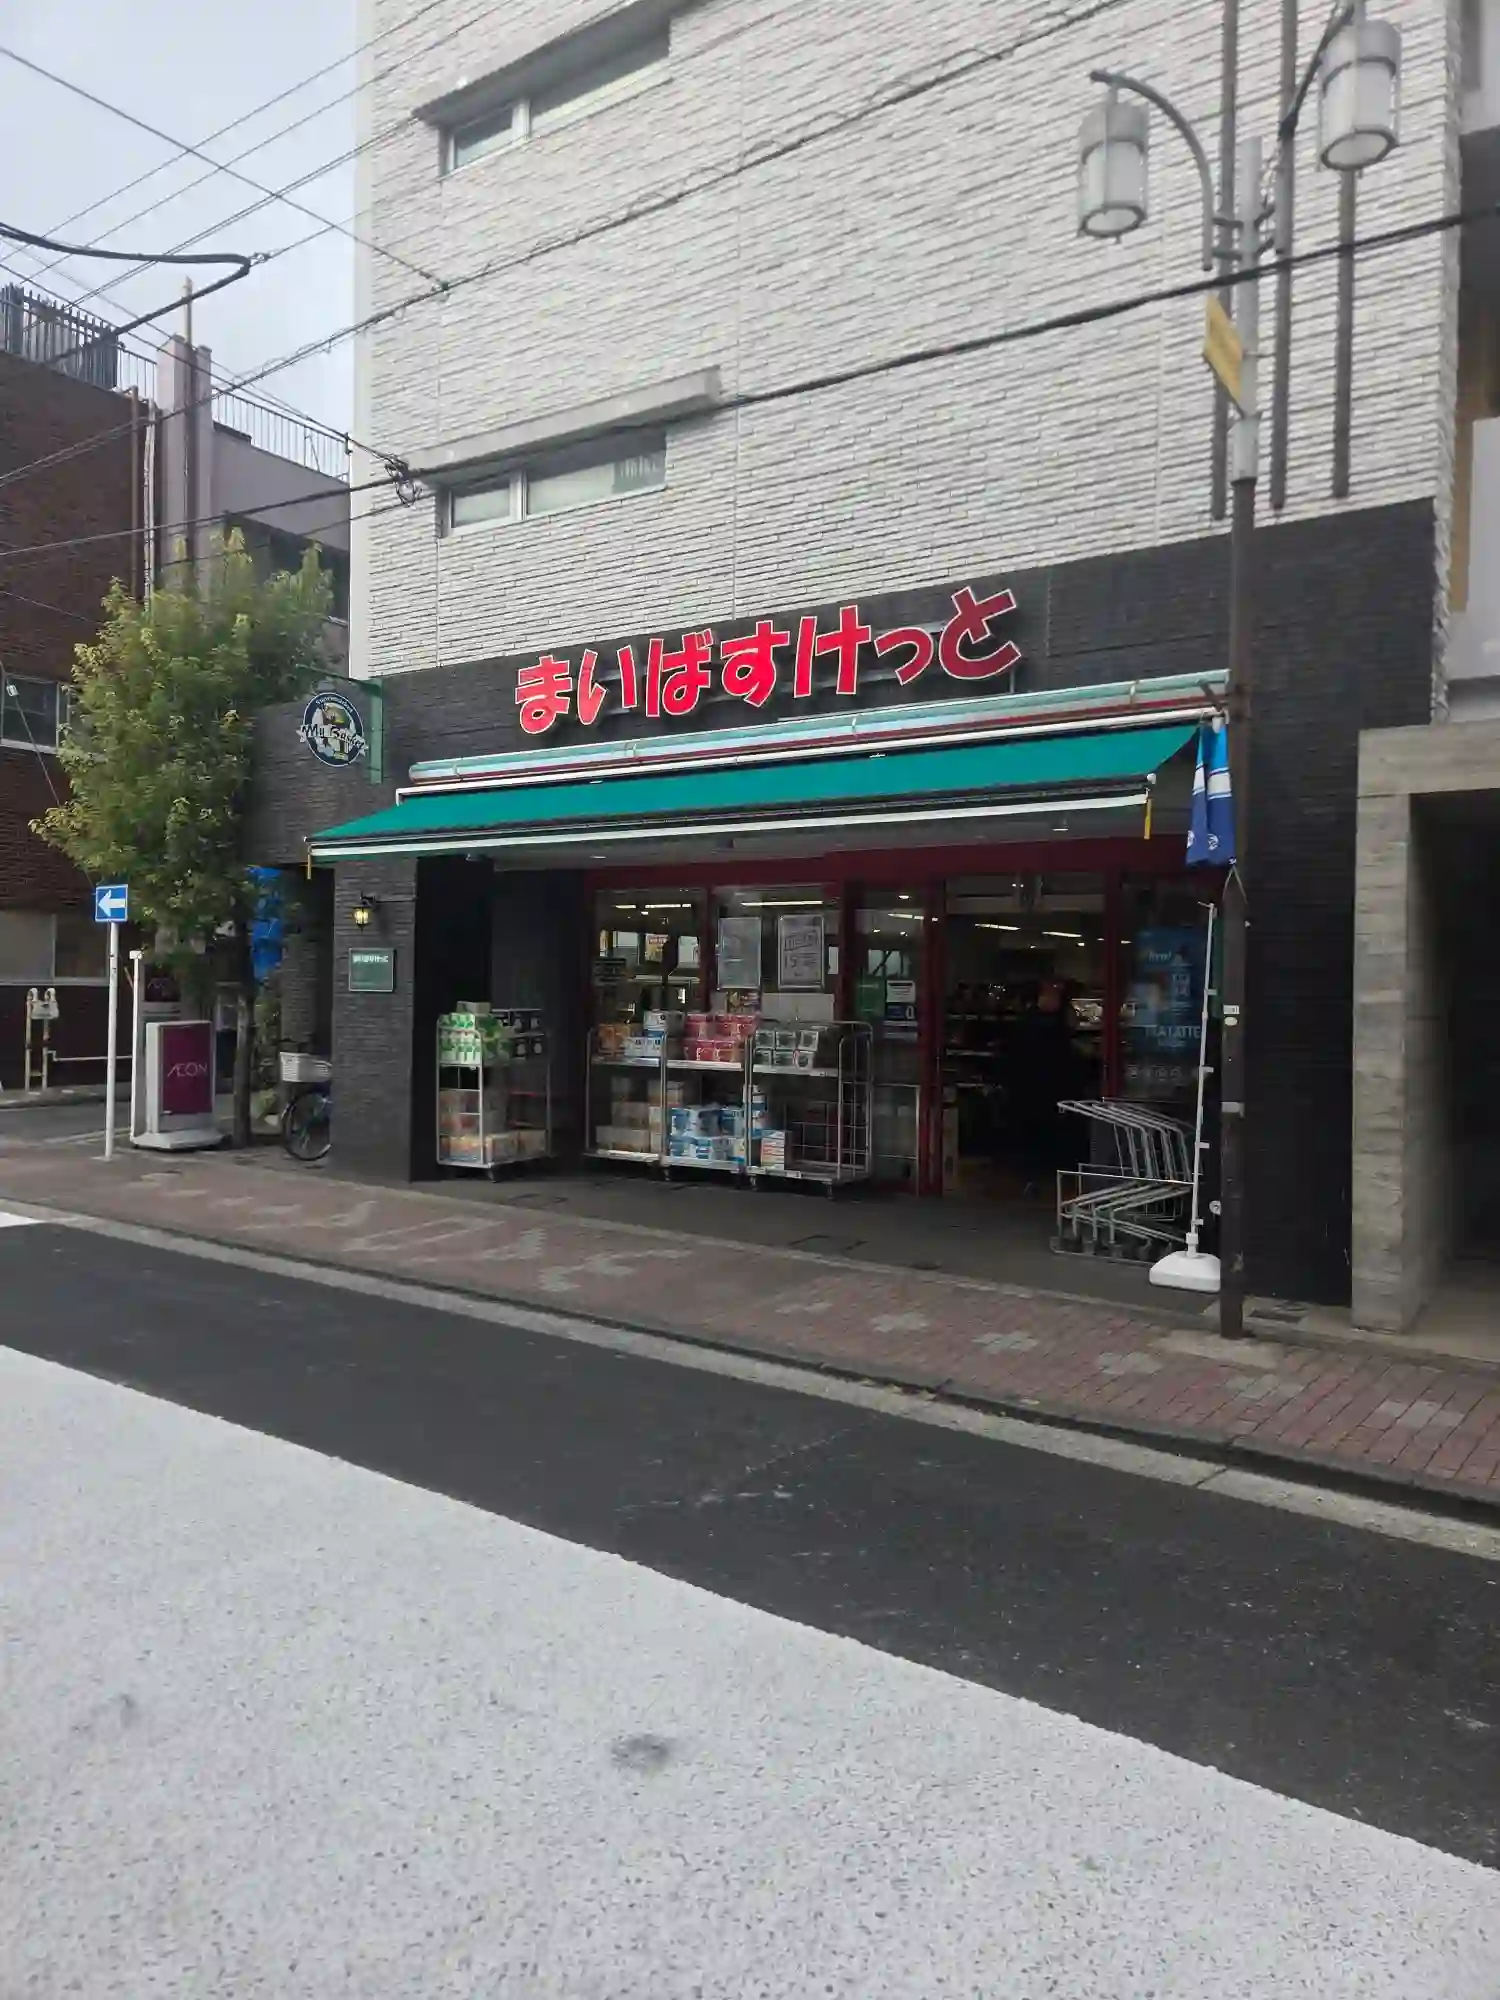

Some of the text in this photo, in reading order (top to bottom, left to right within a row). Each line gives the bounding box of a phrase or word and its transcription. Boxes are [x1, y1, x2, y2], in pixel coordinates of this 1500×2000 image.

[515, 586, 1021, 734] まいばすけっと
[301, 723, 325, 739] My
